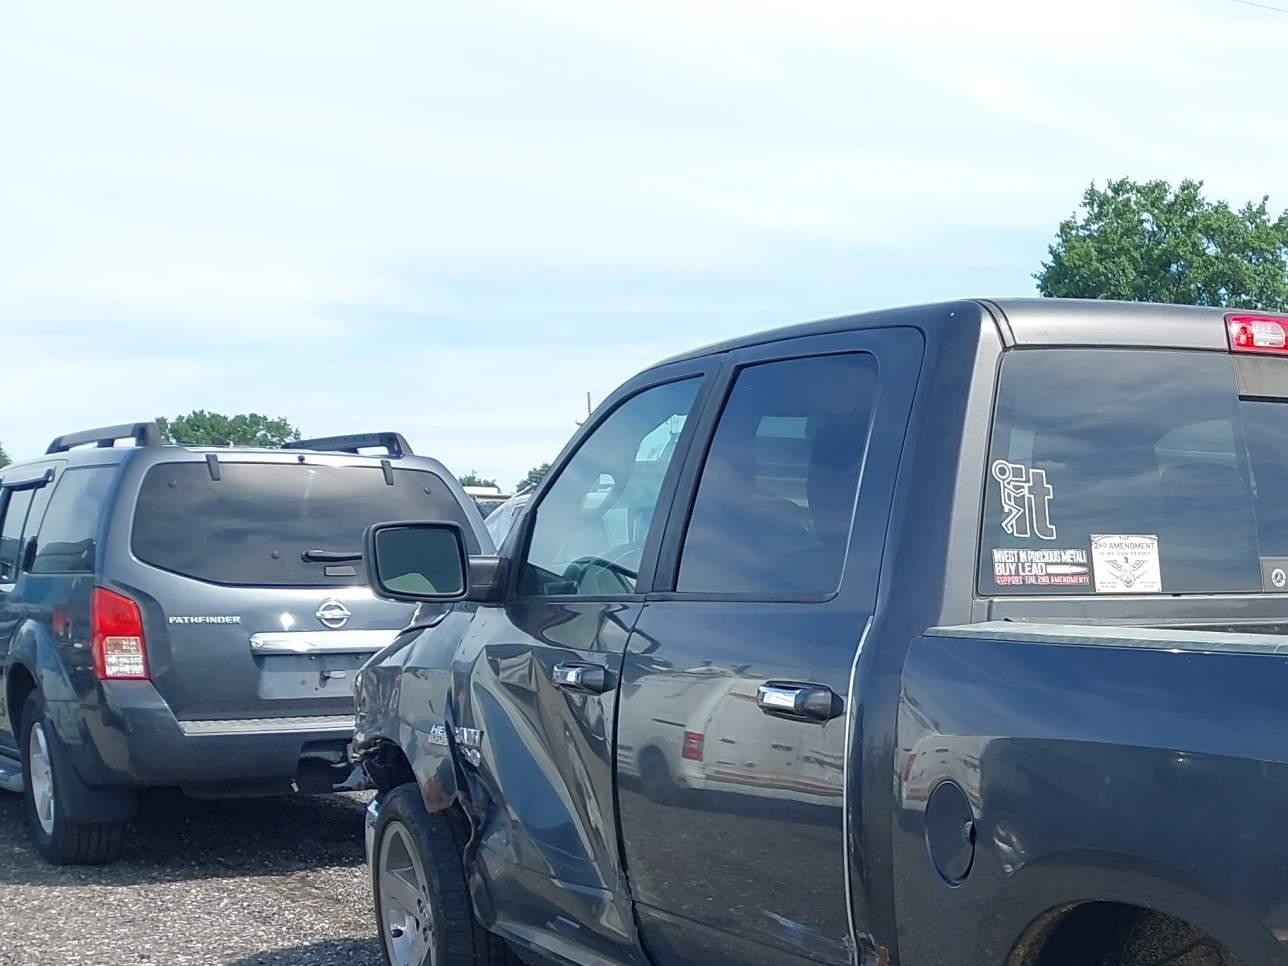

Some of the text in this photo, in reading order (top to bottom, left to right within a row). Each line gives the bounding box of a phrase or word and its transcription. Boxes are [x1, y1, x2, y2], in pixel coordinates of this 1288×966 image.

[1108, 542, 1155, 550] AMENDMENT
[993, 550, 1019, 563] INVEST
[1019, 550, 1028, 563] IN
[1028, 550, 1061, 563] PRECIOUS
[994, 562, 1046, 575] BUY LEAD
[169, 615, 241, 624] PATHFINDER
